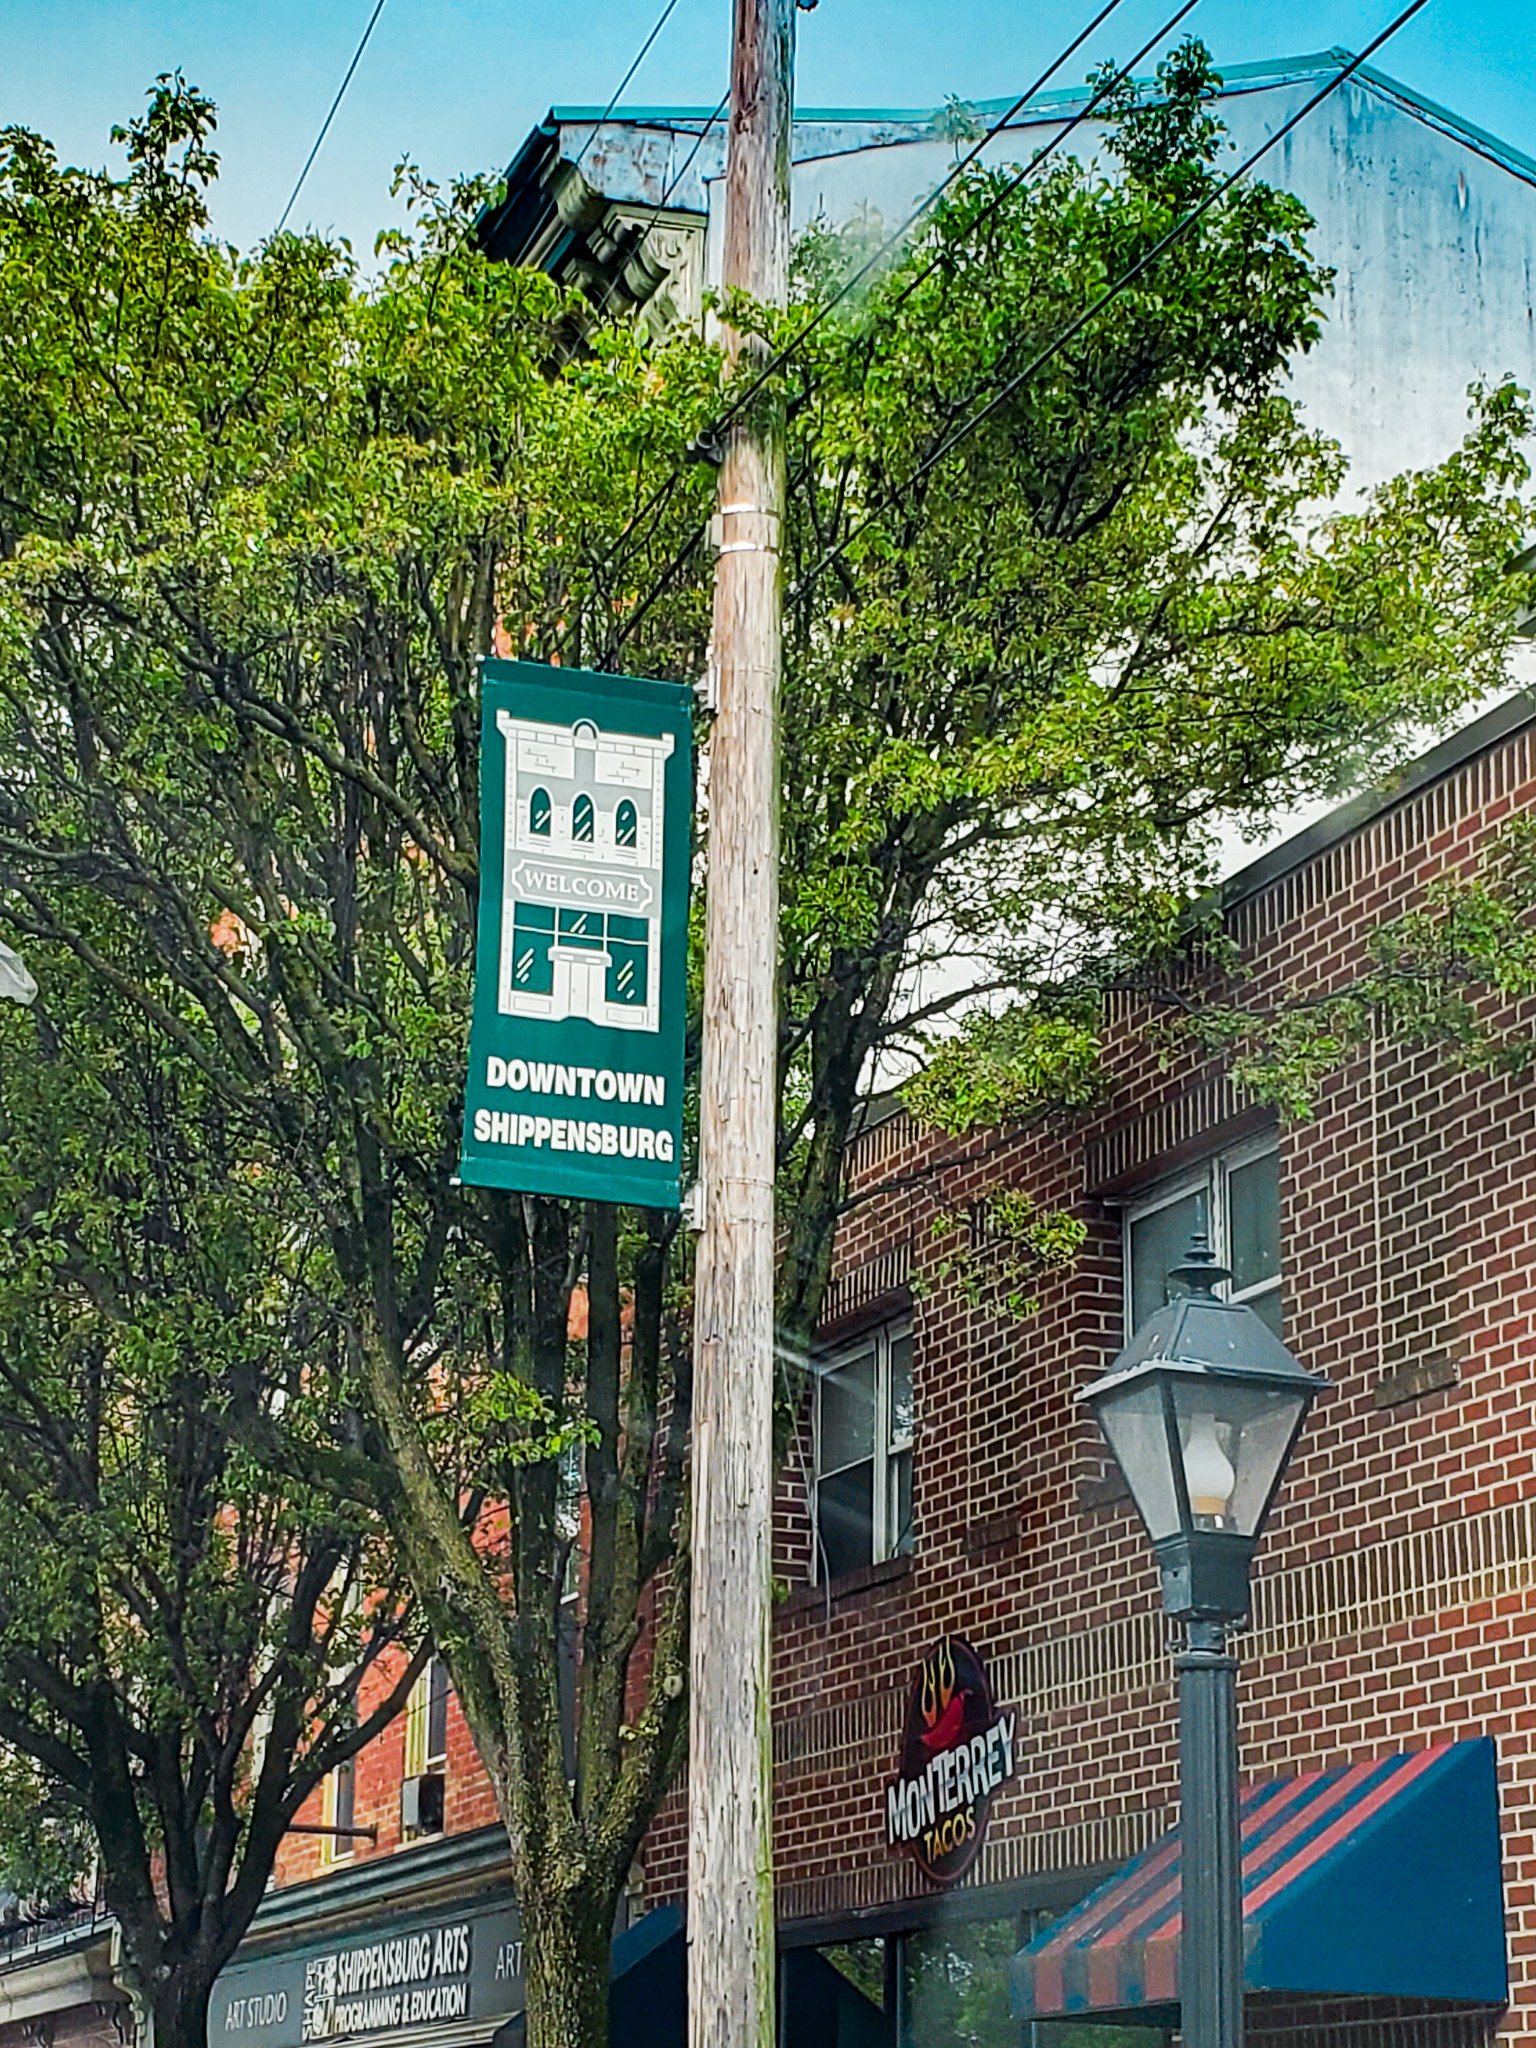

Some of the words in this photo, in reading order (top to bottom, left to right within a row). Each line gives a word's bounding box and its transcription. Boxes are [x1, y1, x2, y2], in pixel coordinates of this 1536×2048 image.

[525, 869, 639, 901] WELCOME
[486, 1055, 666, 1106] DOWNTOWN
[473, 1109, 675, 1162] SHIPPENSBURG
[888, 1712, 1017, 1845] MONTERREY
[924, 1806, 976, 1865] TACOS
[336, 1933, 431, 1996] SHIPPENSBURG
[432, 1924, 469, 1976] ARTS
[495, 1941, 523, 1980] ART
[225, 2001, 246, 2031] ART
[247, 1991, 287, 2028] STUDIO
[302, 1961, 316, 2041] SHAPE
[335, 1994, 401, 2033] PROGRAMMING
[401, 1992, 410, 2023] &
[410, 1982, 467, 2021] EDUCATION
